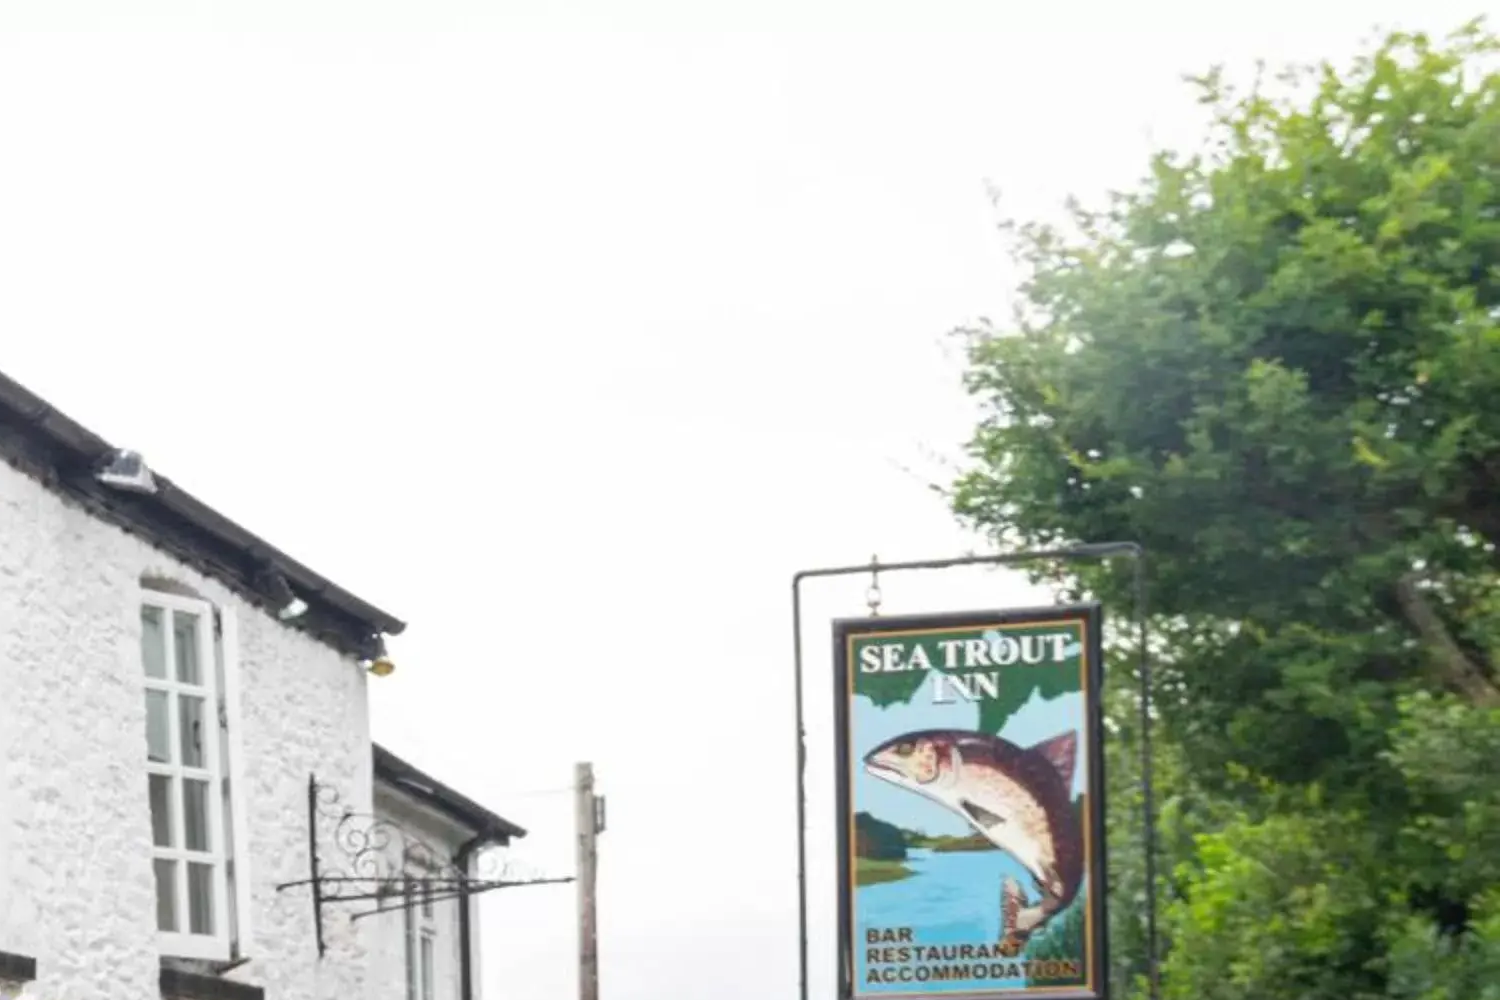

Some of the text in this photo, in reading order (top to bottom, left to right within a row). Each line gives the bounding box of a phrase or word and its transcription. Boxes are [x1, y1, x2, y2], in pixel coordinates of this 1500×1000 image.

[859, 633, 1073, 673] SEA TROUT
[932, 672, 999, 704] INN
[866, 927, 913, 944] BAR
[866, 943, 1021, 964] RESTAURANT
[866, 962, 1078, 983] ACCOMMODATION
